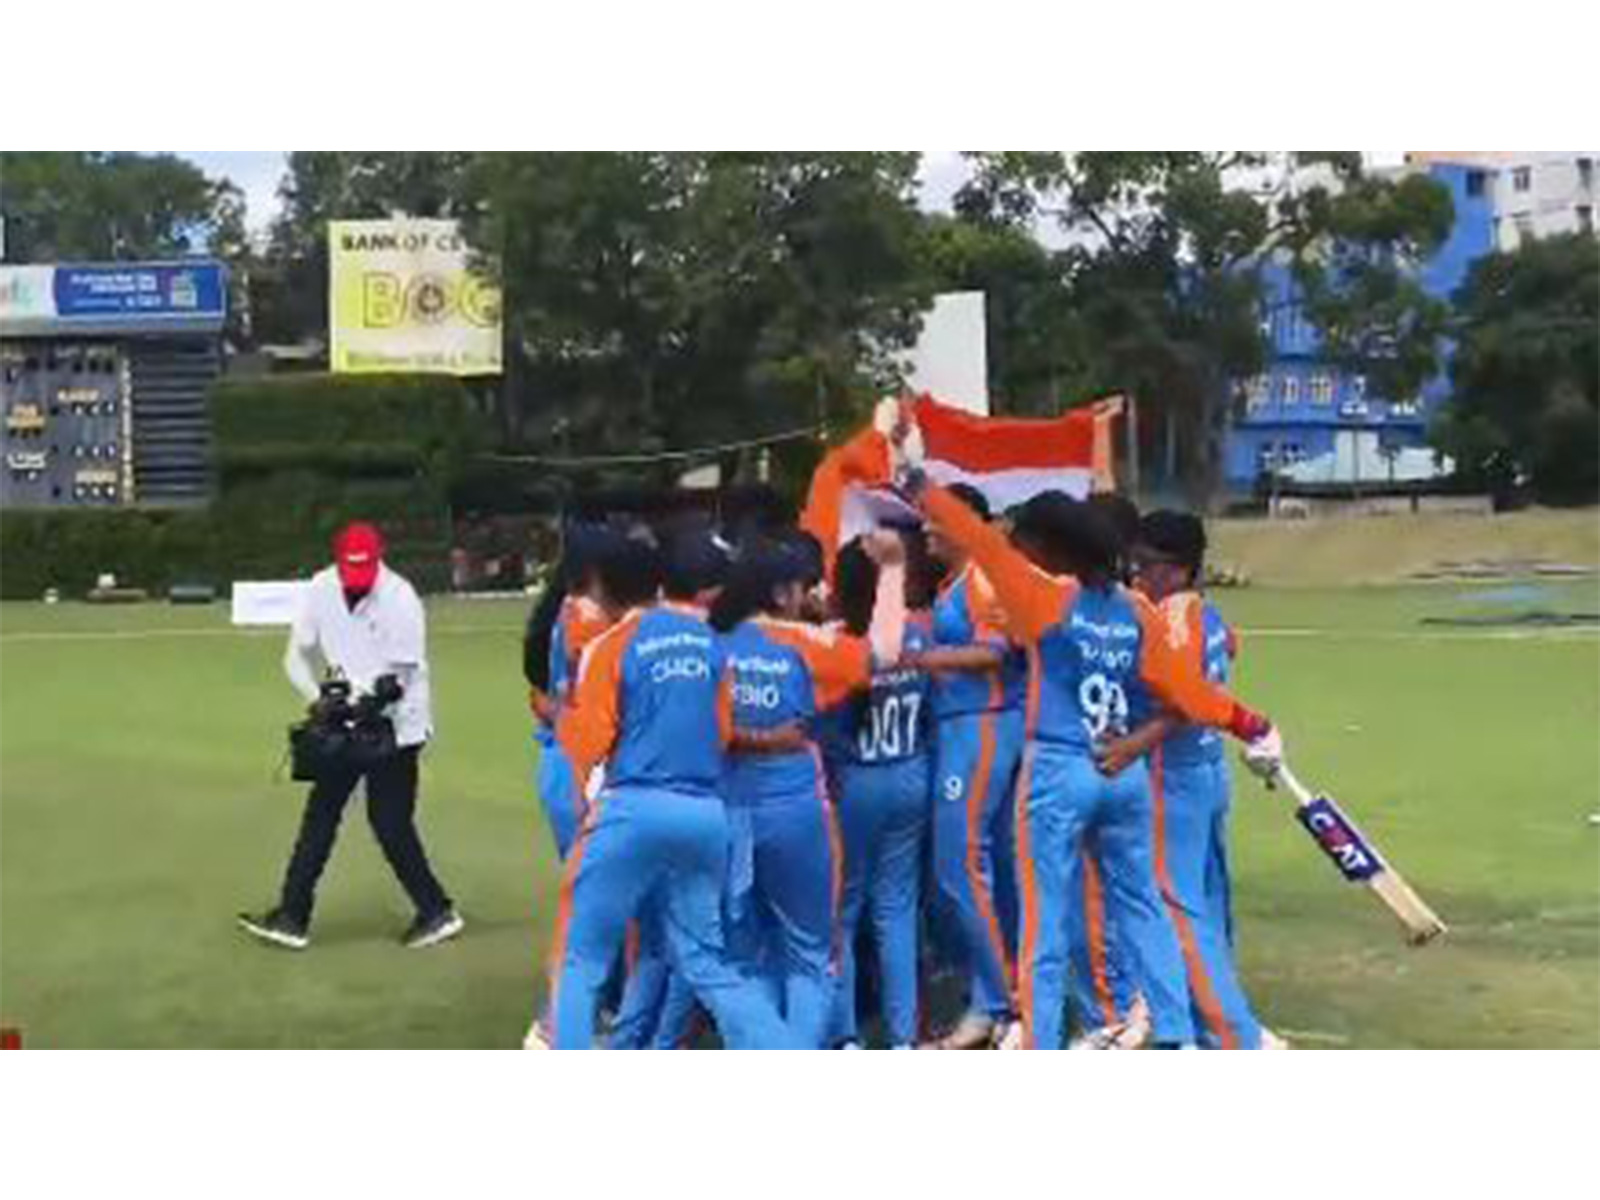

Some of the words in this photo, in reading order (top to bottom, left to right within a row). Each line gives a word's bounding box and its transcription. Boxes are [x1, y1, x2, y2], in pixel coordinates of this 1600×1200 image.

[341, 233, 397, 251] BANK
[403, 234, 428, 252] OF
[944, 775, 963, 801] 9
